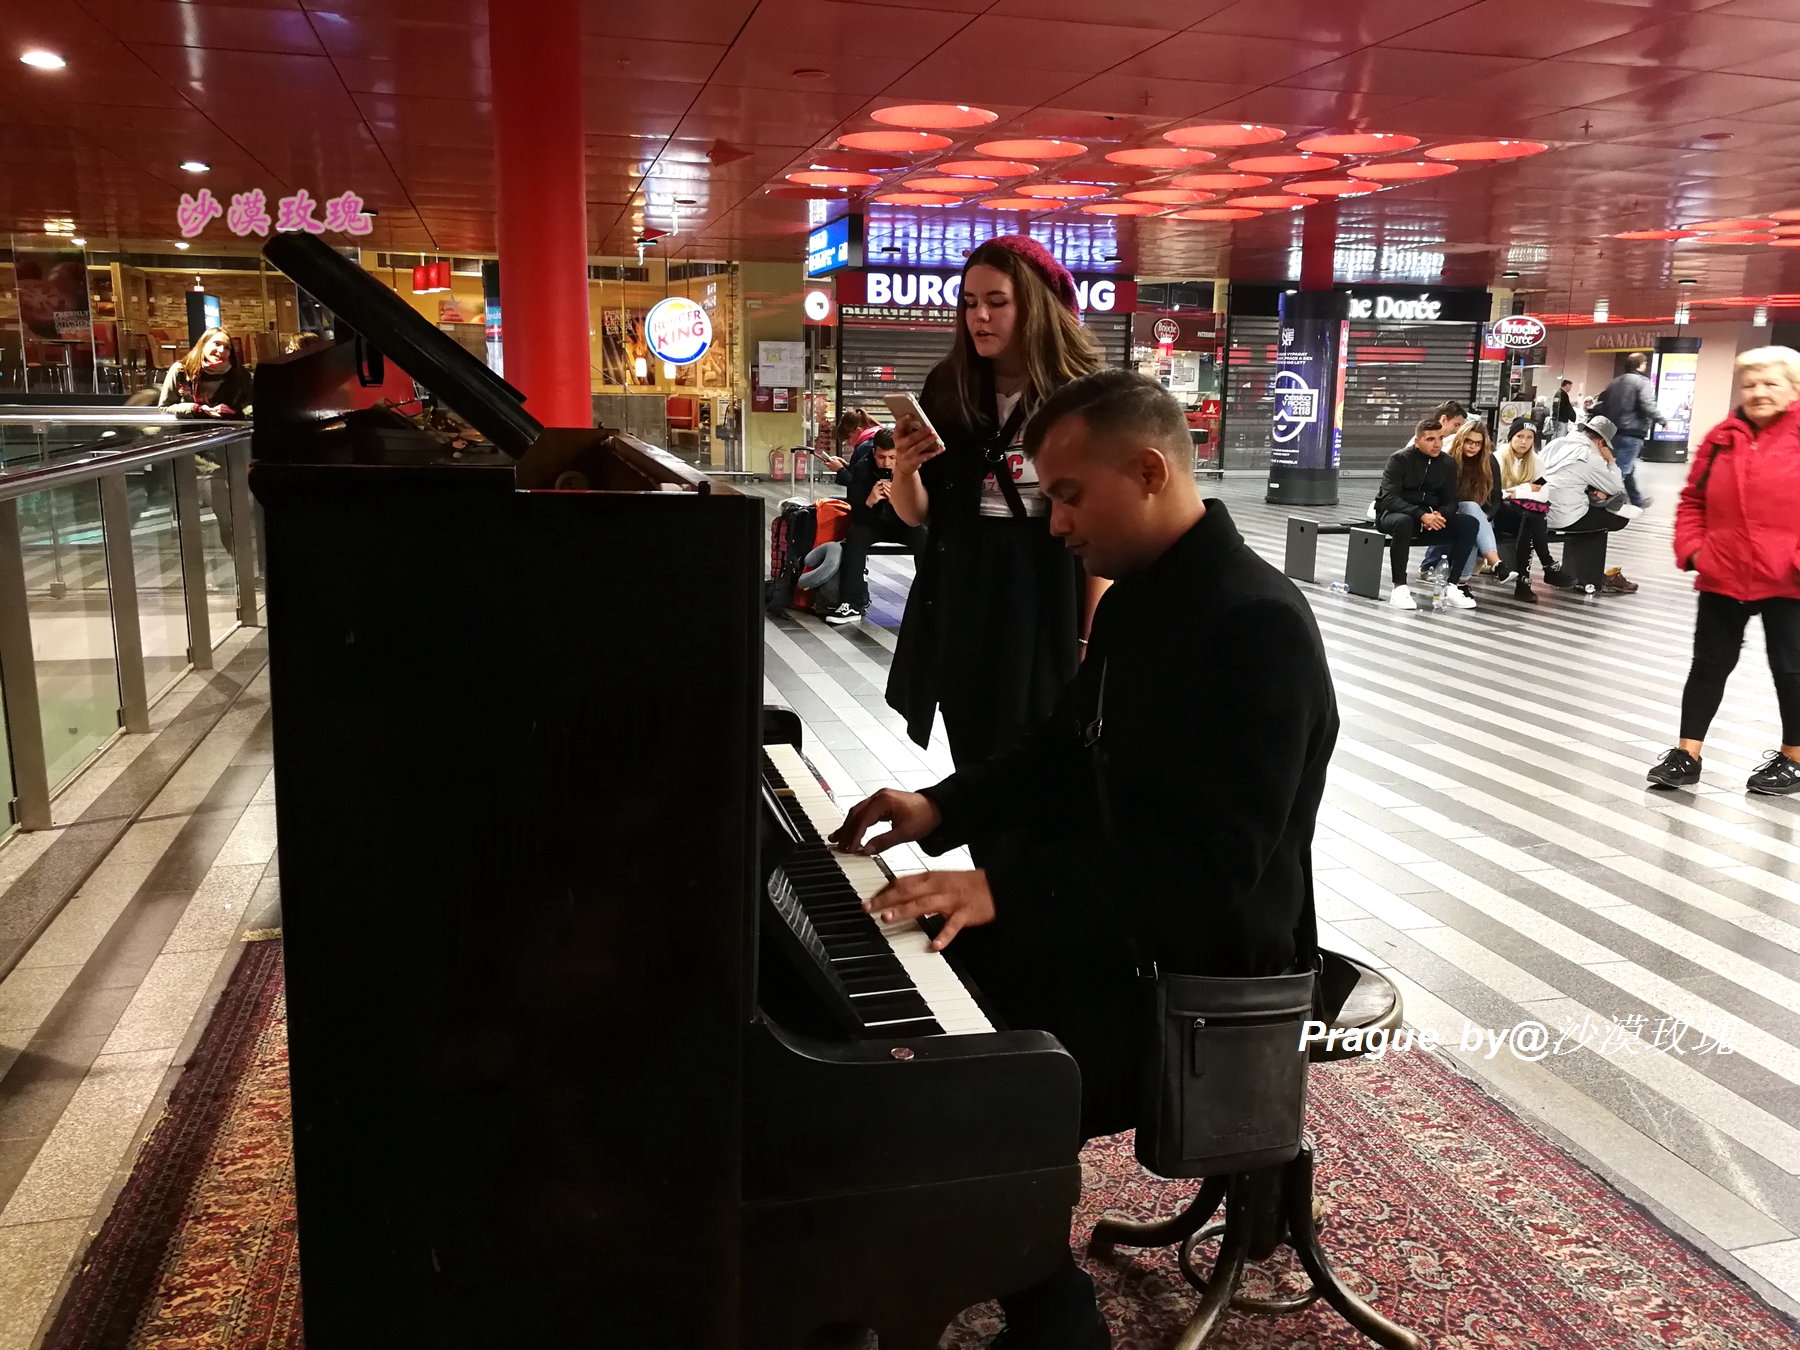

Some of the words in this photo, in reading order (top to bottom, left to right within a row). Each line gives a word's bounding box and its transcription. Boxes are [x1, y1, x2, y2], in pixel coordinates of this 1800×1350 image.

[866, 273, 962, 307] BURG
[1376, 293, 1441, 319] Dorée
[654, 309, 702, 333] BURGER
[1501, 321, 1541, 335] Brioche
[657, 321, 704, 350] KING
[1505, 334, 1535, 345] Dorée
[1292, 406, 1311, 415] 2118
